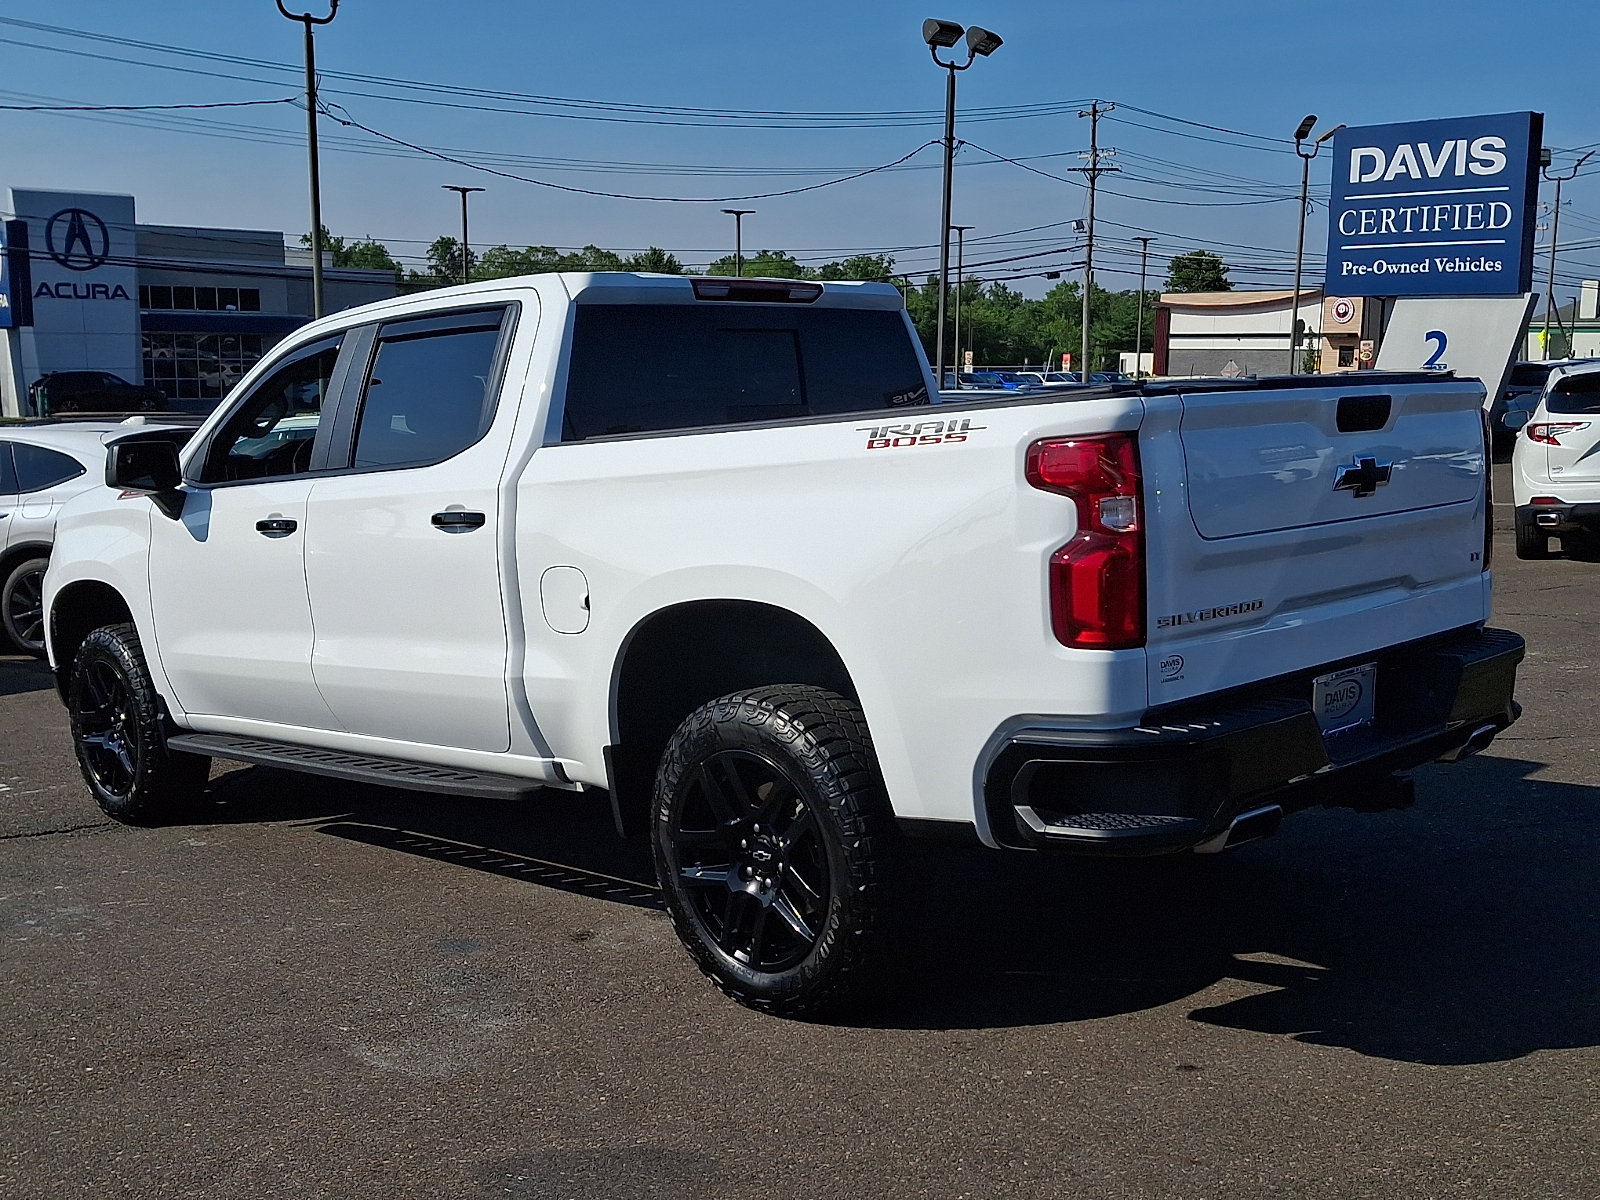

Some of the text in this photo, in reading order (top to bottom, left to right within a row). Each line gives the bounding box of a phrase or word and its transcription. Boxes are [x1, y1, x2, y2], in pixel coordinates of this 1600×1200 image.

[1349, 136, 1507, 184] DAVIS
[1338, 202, 1512, 236] CERTIFIED
[1341, 256, 1502, 275] Pre-Owned Vehicles
[34, 282, 130, 300] ACURA
[1423, 330, 1448, 369] 2
[856, 419, 987, 438] TRAIL
[867, 432, 968, 449] BOSS
[1157, 599, 1264, 629] SILVERADO
[1160, 658, 1180, 669] DAVIS
[1325, 686, 1356, 706] DAVIS
[1325, 701, 1353, 713] ACURA
